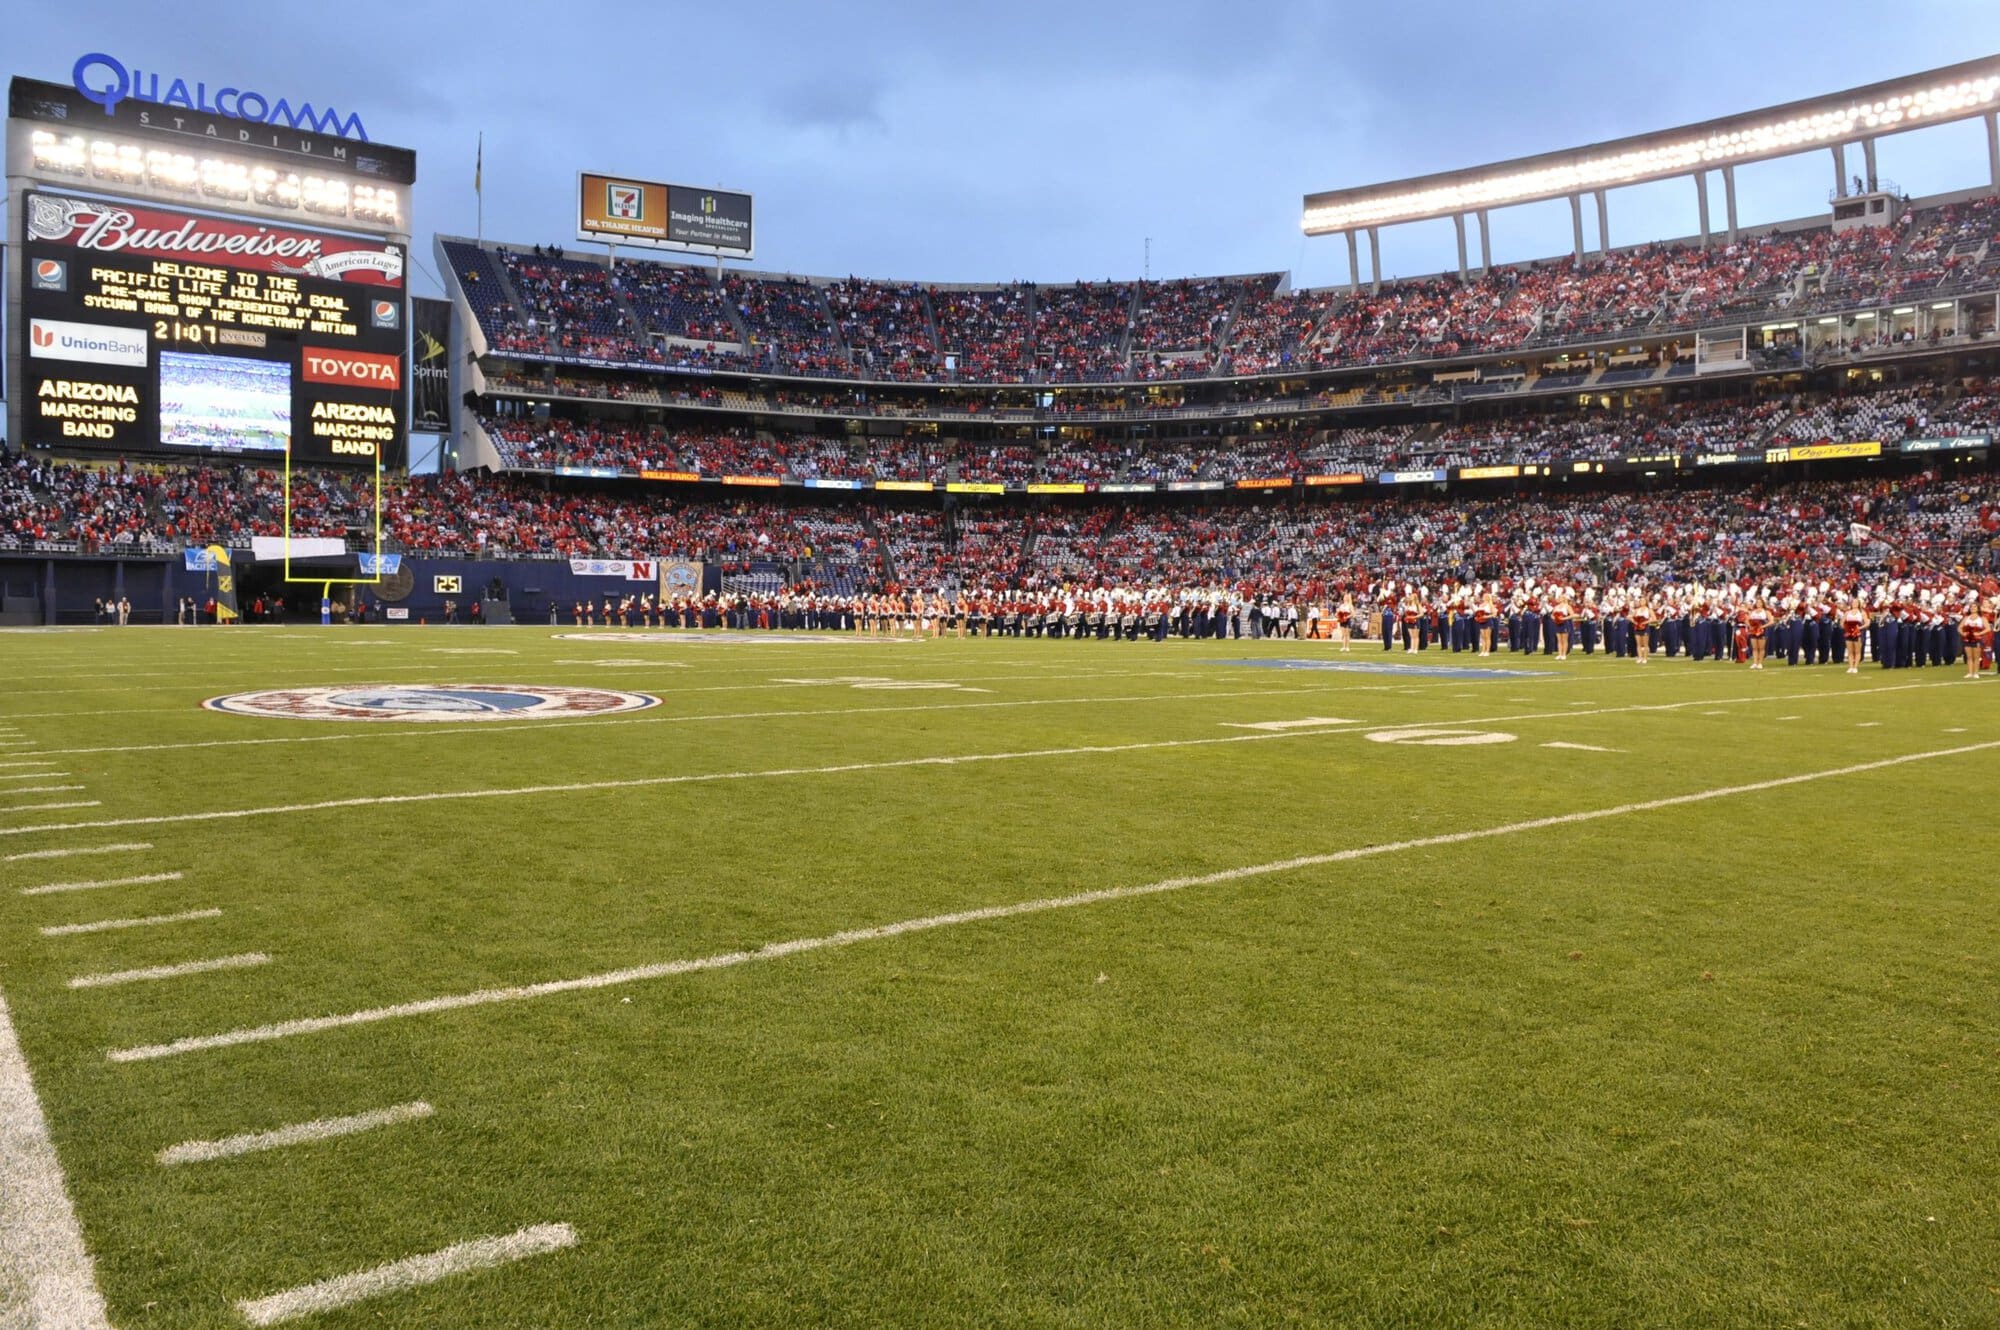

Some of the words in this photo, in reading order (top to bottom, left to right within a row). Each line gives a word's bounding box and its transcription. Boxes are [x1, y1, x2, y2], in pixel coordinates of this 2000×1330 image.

[72, 53, 369, 144] QUALCOMM
[140, 112, 346, 159] STADIUM
[601, 220, 630, 231] THANK
[671, 211, 704, 225] Imaging
[705, 216, 748, 229] Healthcare
[66, 209, 322, 258] Budweiser
[690, 230, 712, 238] Partner
[325, 257, 370, 272] American
[372, 257, 399, 270] Lager
[153, 261, 228, 283] WELCOME
[237, 272, 258, 286] TO
[267, 276, 297, 291] THE
[91, 268, 170, 289] PACIFIC
[179, 279, 222, 295] LIFE
[230, 285, 302, 304] HOLIDAY
[310, 294, 349, 311] BOWL
[101, 285, 171, 302] PRE-GAME
[178, 294, 211, 307] SHOW
[218, 299, 290, 316] PRESENTED
[295, 307, 313, 318] BY
[319, 310, 342, 322] THE
[84, 295, 137, 312] SYCUAN
[144, 301, 179, 316] BAND
[186, 306, 203, 318] OF
[210, 309, 235, 322] THE
[311, 320, 357, 336] NATION
[155, 321, 216, 344] 21:07
[221, 332, 265, 343] SYCUAN
[307, 357, 396, 382] TOYOTA
[413, 364, 448, 379] Sprint
[38, 379, 139, 404] ARIZONA
[41, 401, 136, 422] MARCHING
[311, 402, 396, 424] ARIZONA
[63, 421, 114, 438] BAND
[313, 421, 394, 441] MARCHING
[332, 439, 375, 455] BAND
[642, 471, 671, 480] WELLS
[672, 472, 698, 481] FARGO
[1265, 478, 1291, 487] FARGO
[632, 562, 651, 579] N
[438, 576, 458, 593] 25
